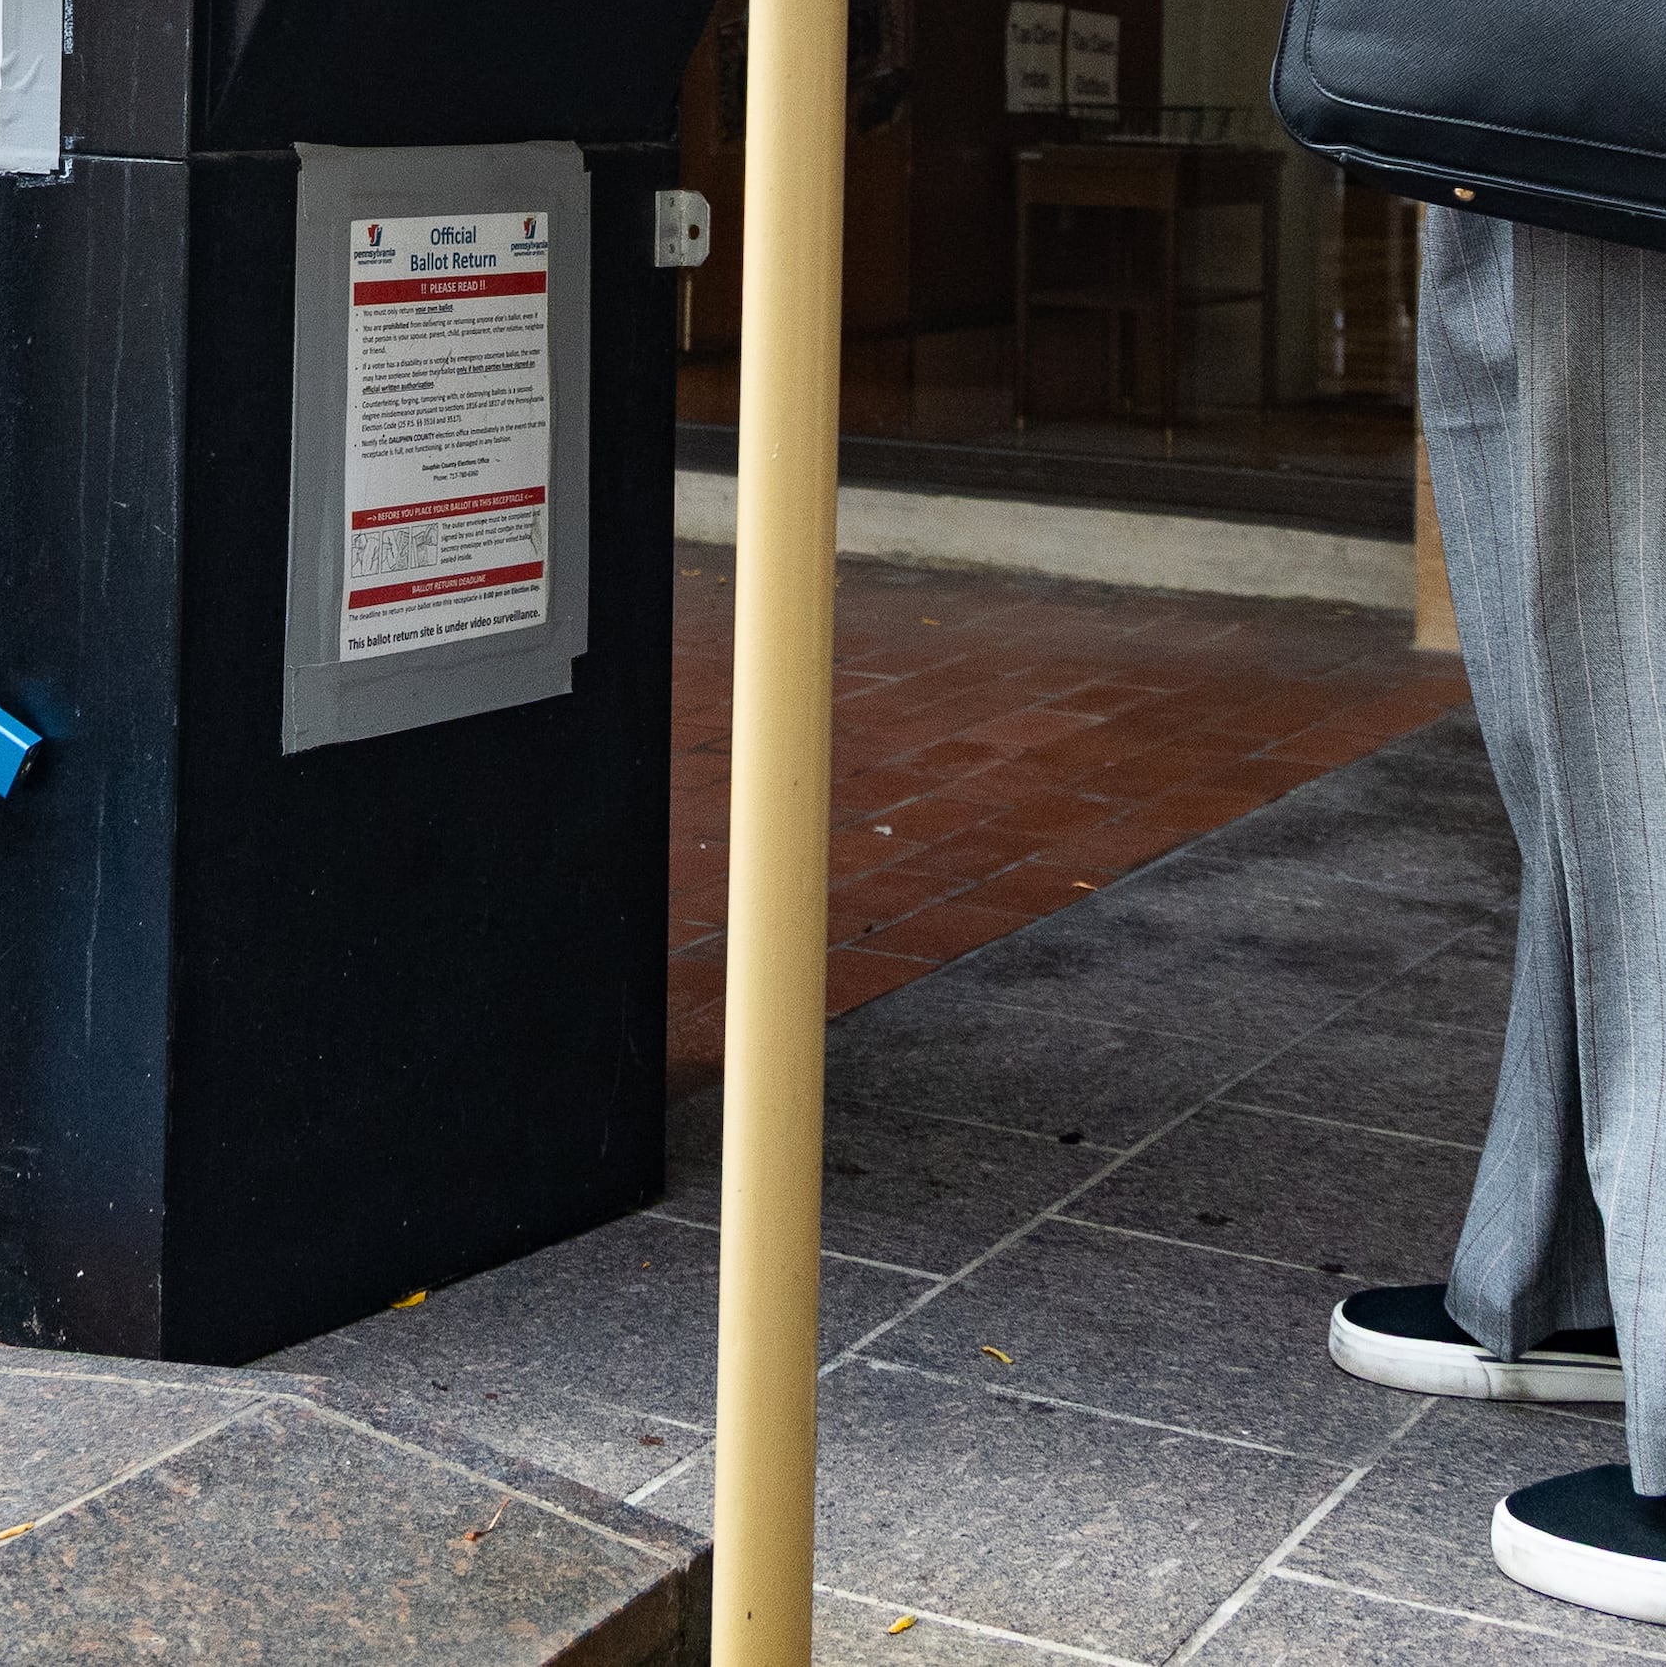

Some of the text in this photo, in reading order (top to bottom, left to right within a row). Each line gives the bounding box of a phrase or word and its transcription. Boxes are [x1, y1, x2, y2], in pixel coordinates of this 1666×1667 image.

[430, 226, 475, 245] Official
[353, 247, 396, 260] pennsylvania
[510, 240, 547, 251] pennsylvania
[410, 253, 449, 271] Ballot
[452, 250, 496, 268] Return
[420, 280, 485, 293] !! PLEASE READ !!
[387, 307, 397, 316] only
[438, 303, 453, 312] ballot.
[377, 510, 400, 521] BEFORE
[401, 508, 413, 518] YOU
[414, 506, 431, 516] PLACE
[433, 503, 449, 513] YOUR
[450, 500, 470, 511] BALLOT
[479, 497, 491, 507] THIS
[492, 493, 523, 505] RECEPTACLE
[412, 574, 485, 594] BALLOT RETURN DEADLINE
[348, 605, 540, 650] This ballot return site is under video surveillance.
